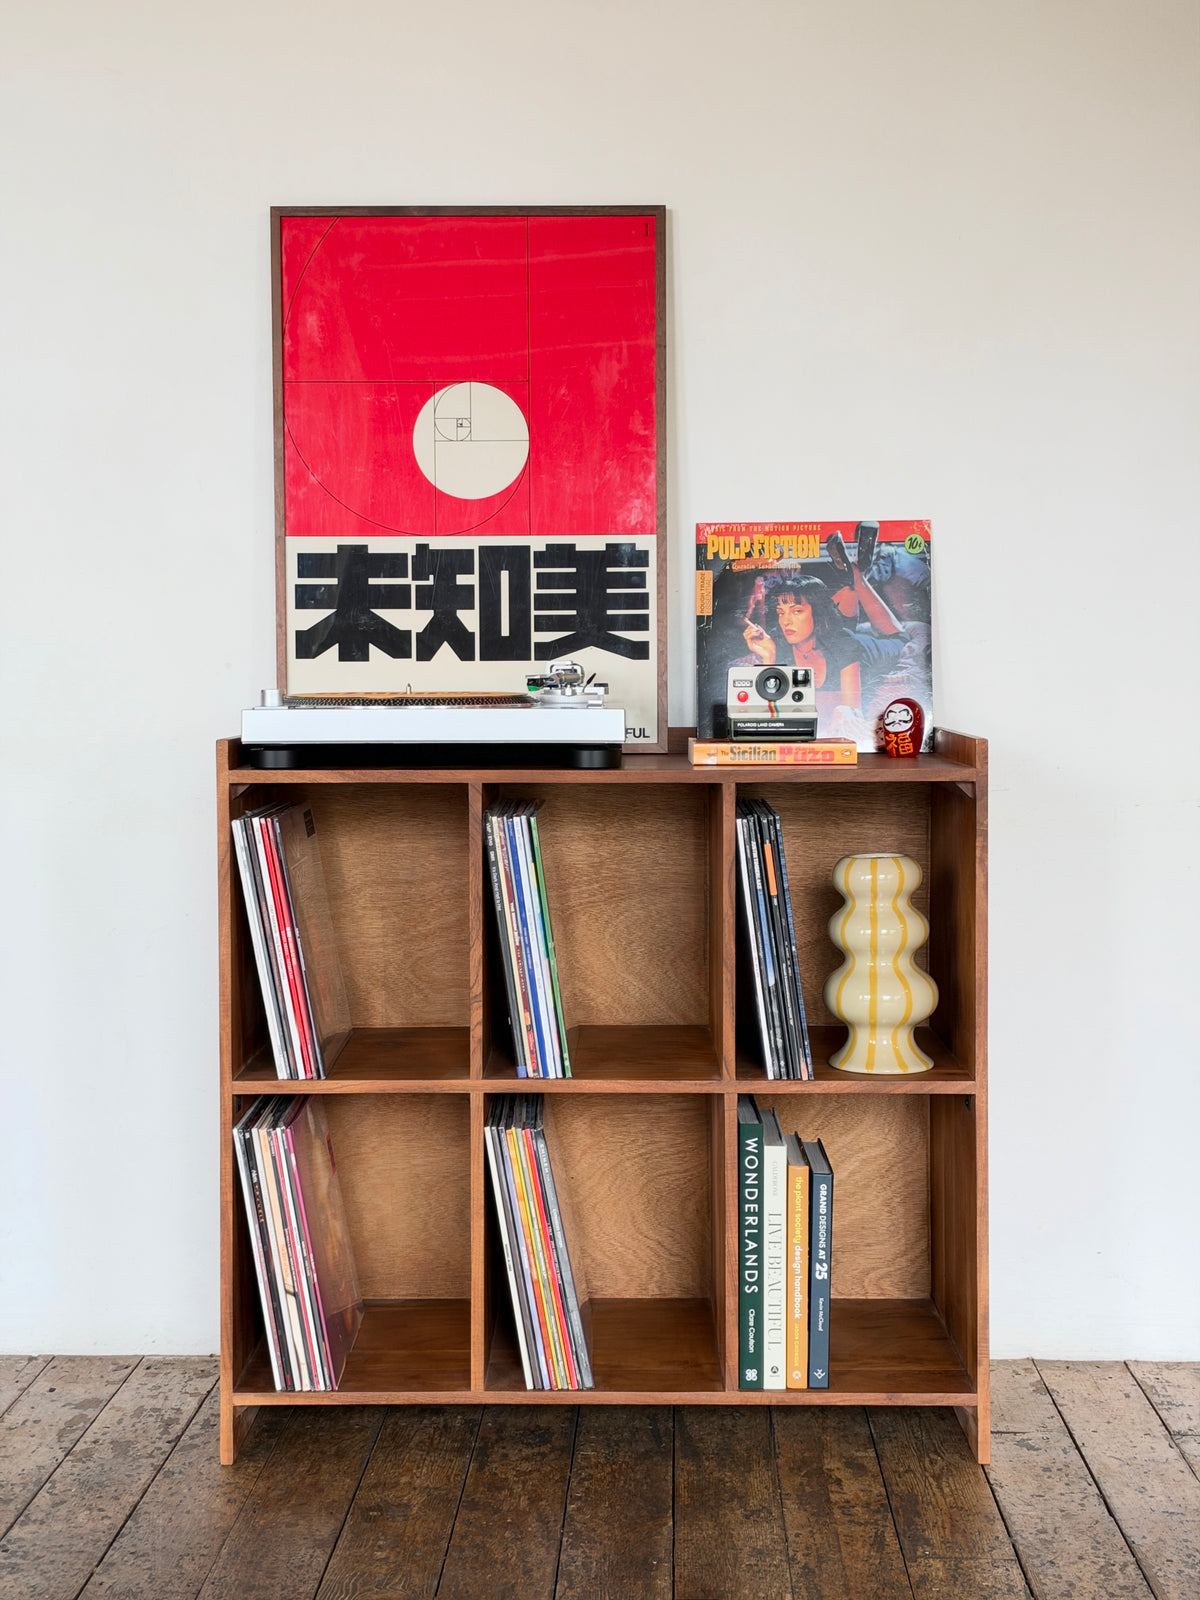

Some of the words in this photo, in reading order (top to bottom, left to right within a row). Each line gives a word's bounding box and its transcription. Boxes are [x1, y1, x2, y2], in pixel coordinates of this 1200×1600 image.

[706, 534, 751, 560] PULP
[752, 533, 820, 559] FICTION
[294, 542, 650, 662] 未知美
[729, 745, 777, 761] Sicilian
[779, 746, 835, 762] Puzo
[540, 1143, 549, 1173] EMINEM
[795, 1176, 803, 1189] the
[793, 1190, 803, 1211] plant
[819, 1183, 828, 1215] GRAND
[744, 1137, 759, 1294] WONDERLANDS
[793, 1213, 803, 1244] society
[767, 1213, 782, 1250] LIVE
[818, 1215, 827, 1248] DESIGNS
[792, 1245, 803, 1274] design
[818, 1248, 826, 1260] AT
[815, 1262, 829, 1280] 25
[767, 1256, 782, 1350] BEAUTIFUL
[793, 1275, 803, 1319] handbook
[748, 1308, 756, 1326] Clare
[748, 1327, 756, 1353] Coulson
